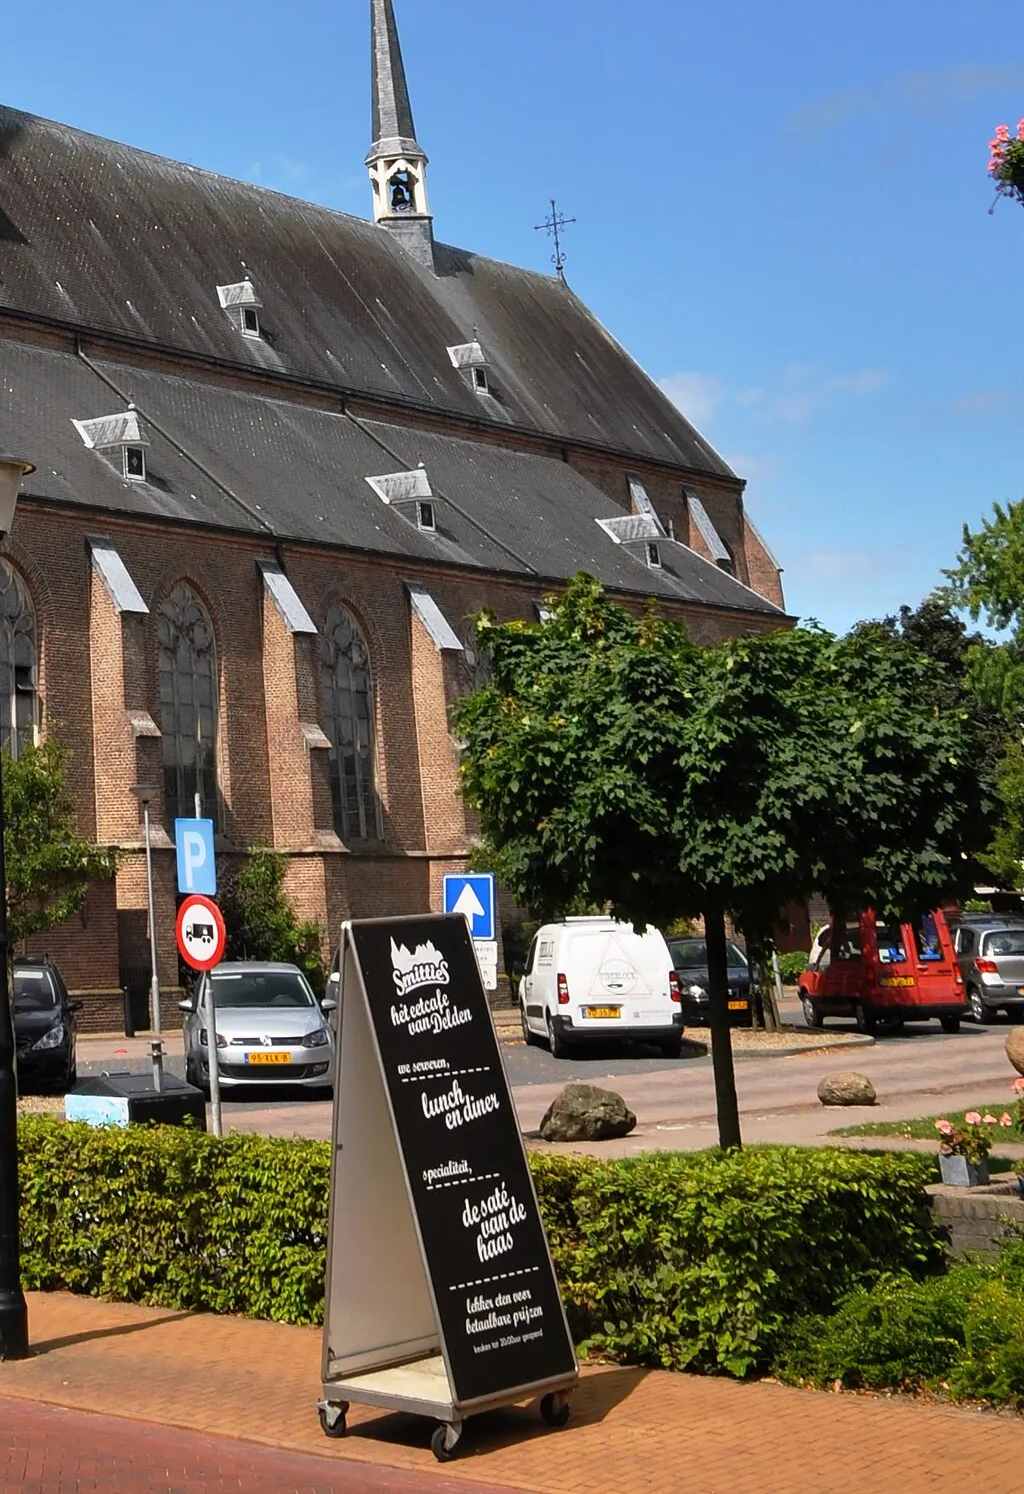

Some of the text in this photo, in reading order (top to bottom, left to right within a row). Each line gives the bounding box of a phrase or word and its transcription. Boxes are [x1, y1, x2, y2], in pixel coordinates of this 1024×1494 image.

[183, 831, 206, 888] P
[408, 1005, 473, 1036] van Delden
[397, 1058, 450, 1075] we serveren,
[421, 1079, 465, 1119] lunch
[445, 1092, 500, 1130] en diner
[422, 1159, 473, 1185] specialiteit,
[480, 1196, 527, 1239] van de
[476, 1231, 514, 1263] haas
[466, 1289, 532, 1314] lekker eten voor
[465, 1305, 544, 1335] betaalbare prijzen
